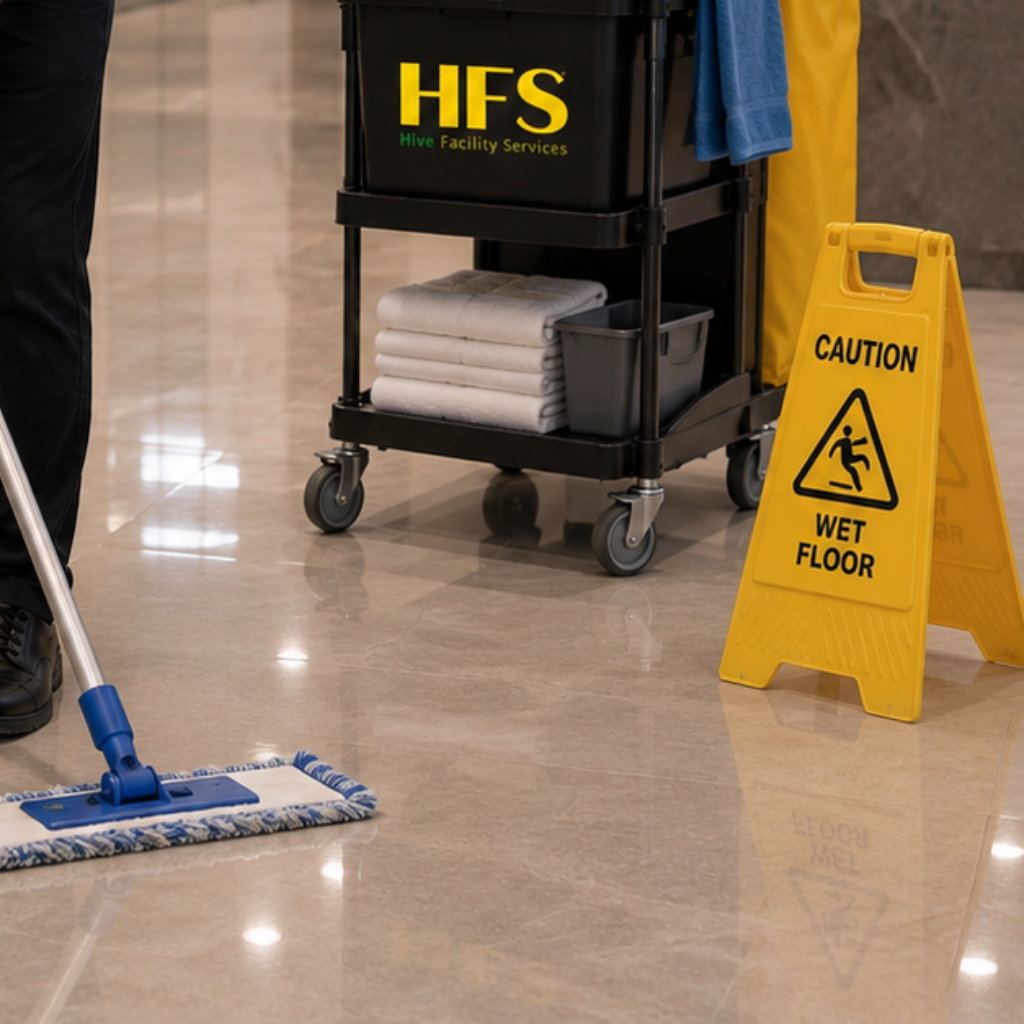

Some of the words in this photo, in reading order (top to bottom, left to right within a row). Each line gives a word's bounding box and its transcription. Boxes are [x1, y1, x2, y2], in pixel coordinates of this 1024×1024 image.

[400, 61, 569, 135] HFS
[399, 132, 434, 148] Hive
[440, 134, 498, 155] Facility
[503, 138, 568, 156] Services
[814, 333, 919, 373] CAUTION
[815, 512, 867, 544] WET
[795, 541, 875, 579] FLOOR
